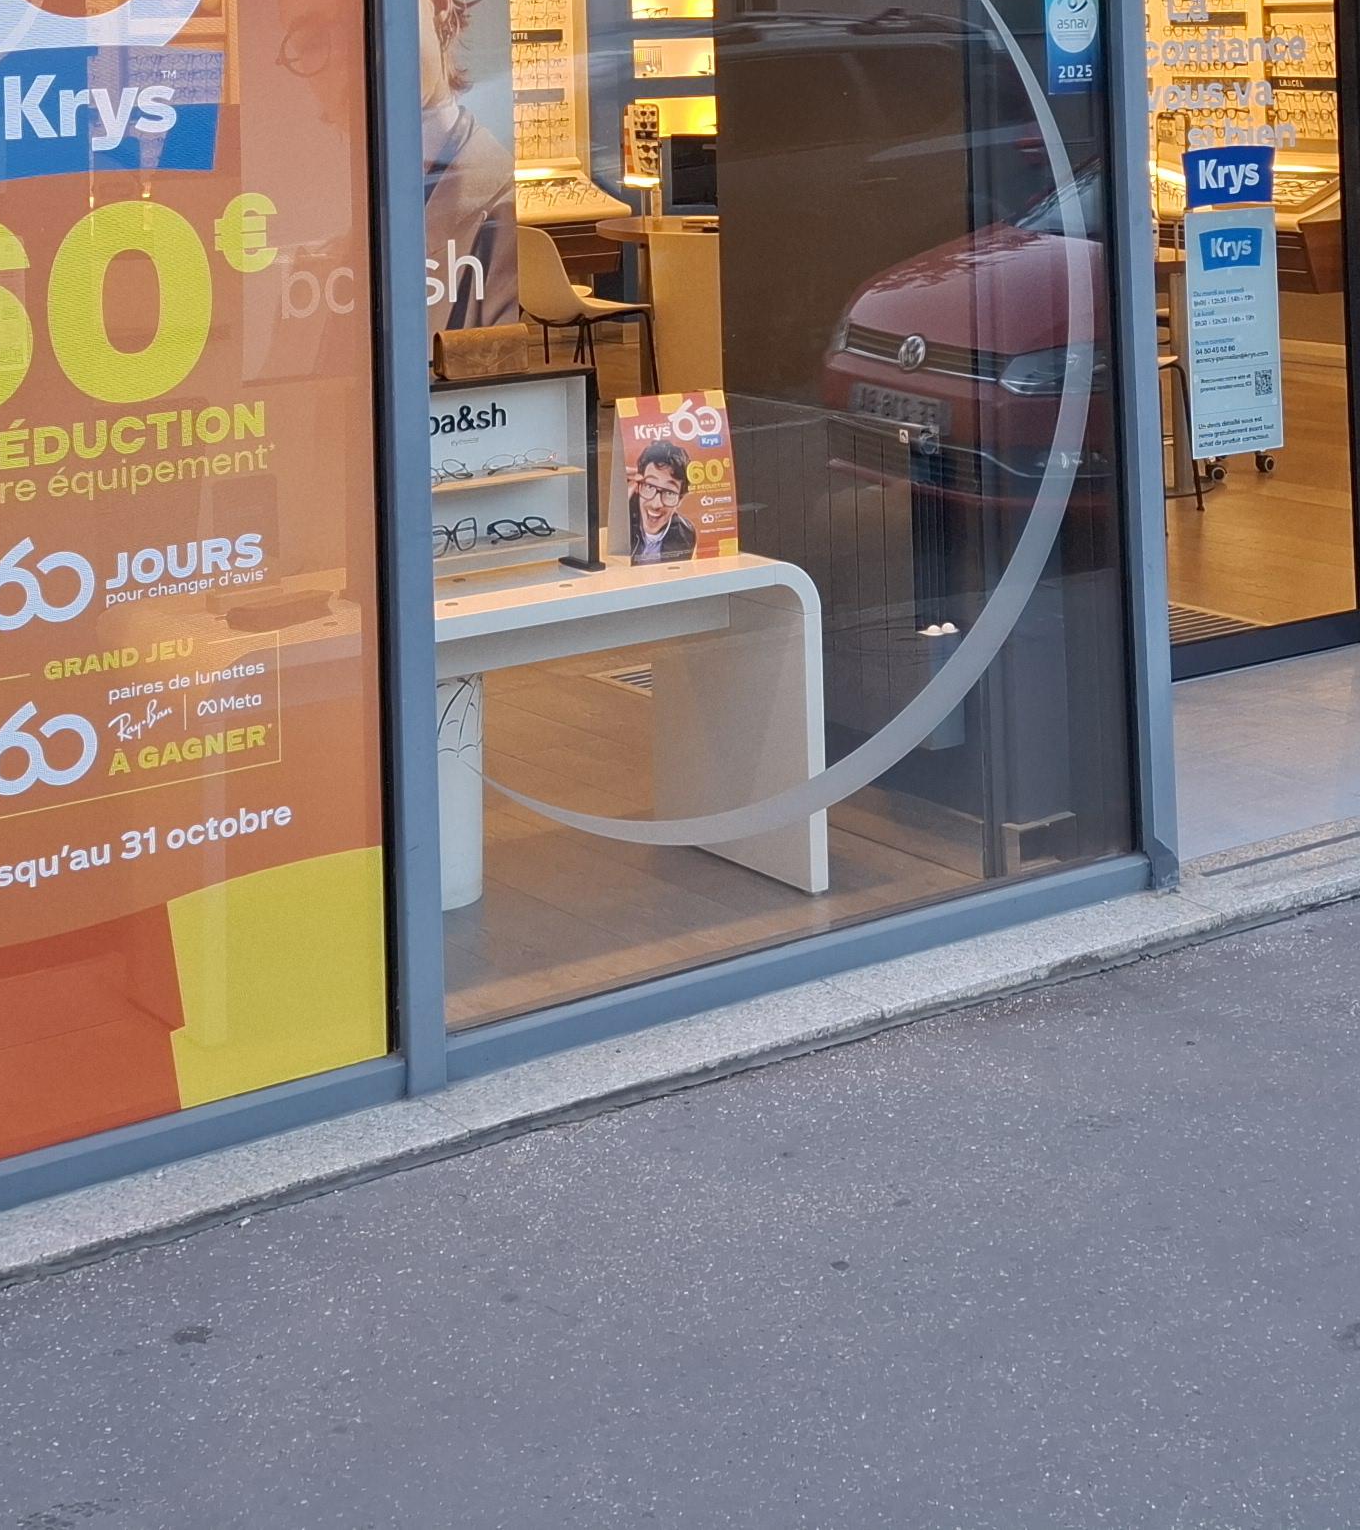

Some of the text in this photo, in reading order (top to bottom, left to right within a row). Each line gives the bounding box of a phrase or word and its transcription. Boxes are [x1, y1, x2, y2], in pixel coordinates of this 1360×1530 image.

[1056, 18, 1090, 30] asnav
[1144, 27, 1307, 67] confiance
[1058, 64, 1093, 79] 2025
[2, 74, 177, 152] Krys
[1147, 81, 1224, 111] vous
[1197, 158, 1260, 195] Krys
[1210, 235, 1252, 261] Krys
[633, 424, 671, 441] Krys
[105, 533, 263, 589] JOURS
[105, 589, 143, 608] pour
[148, 577, 215, 601] changer
[44, 638, 194, 680] GRAND JEU
[108, 680, 164, 705] paires
[168, 674, 190, 690] de
[195, 662, 265, 687] lunettes
[108, 693, 262, 742] Ray-Ban Meta
[108, 748, 131, 776] À
[120, 827, 157, 860] 31
[167, 805, 292, 849] octobre
